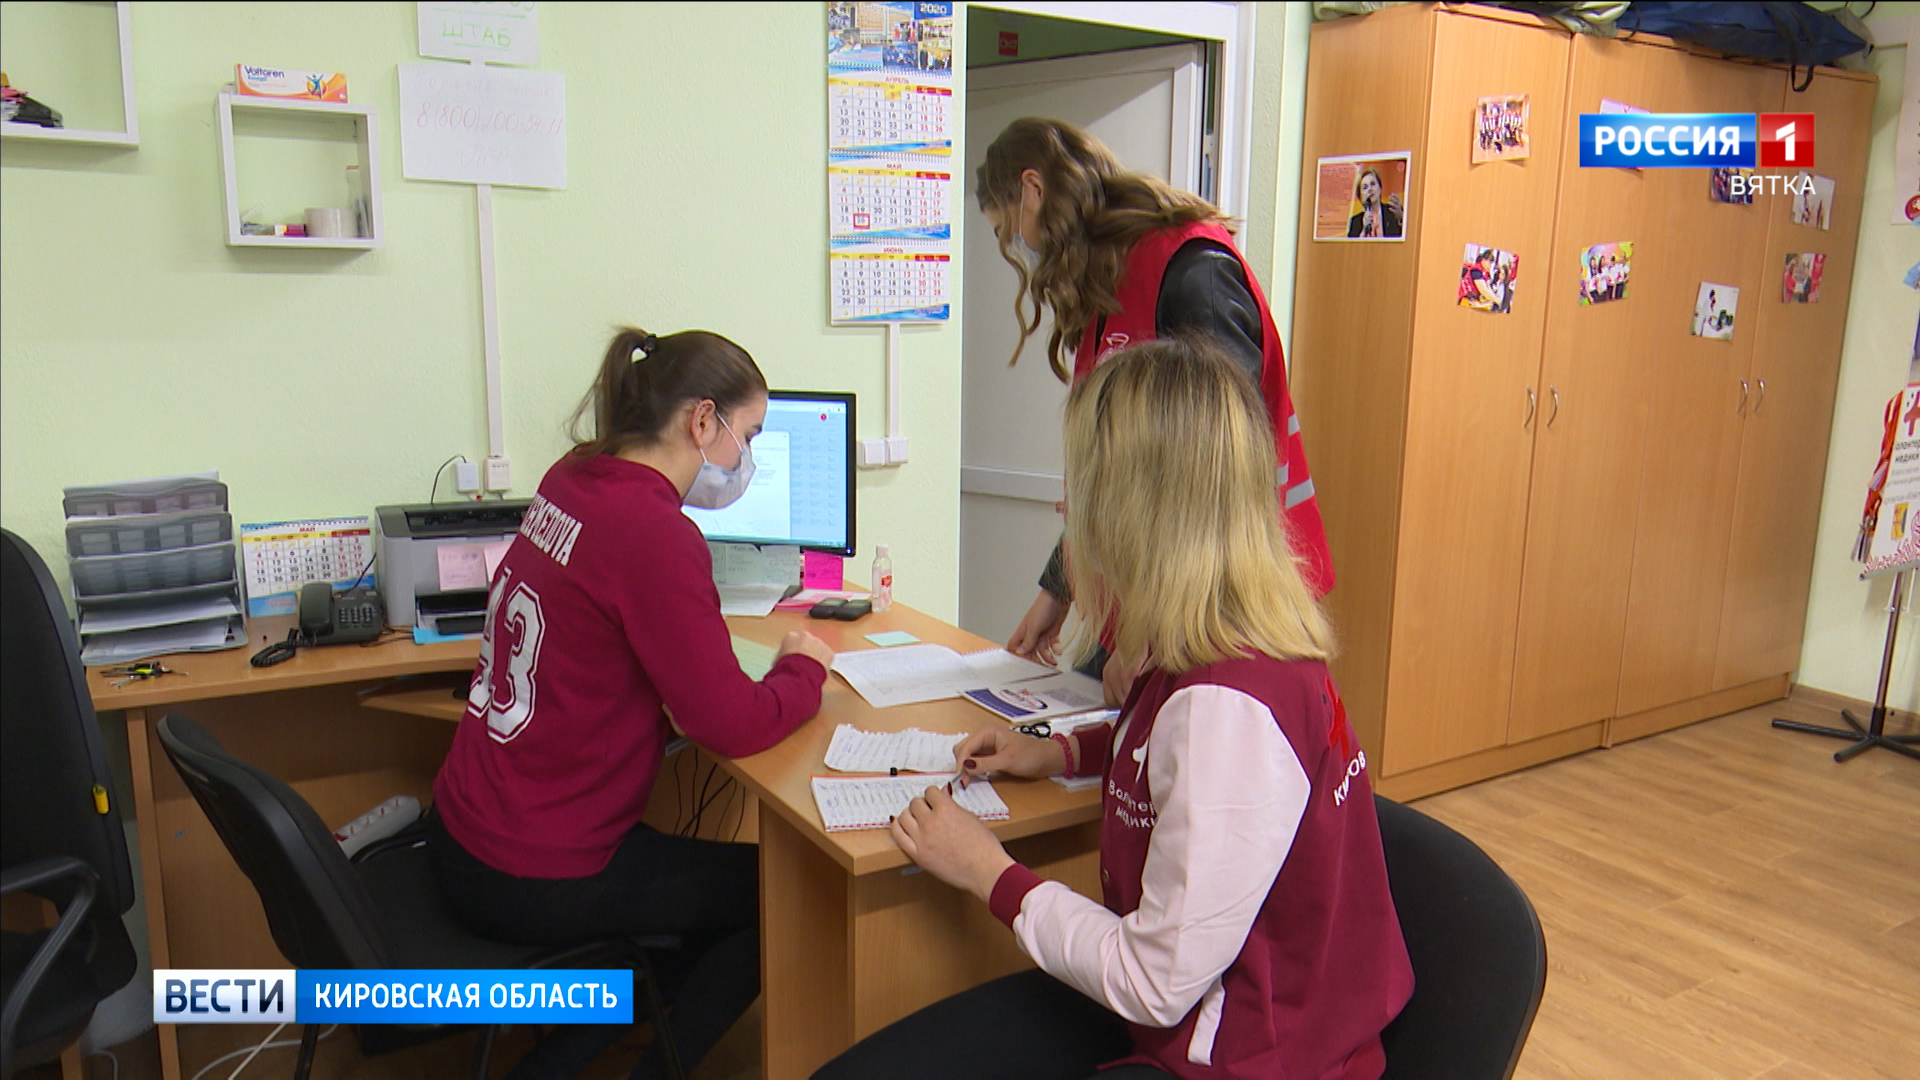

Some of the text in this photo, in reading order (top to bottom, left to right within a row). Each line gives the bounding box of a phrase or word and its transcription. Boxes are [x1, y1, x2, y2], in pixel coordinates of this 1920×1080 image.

[920, 3, 947, 14] 2020
[441, 17, 511, 47] ШТАБ
[244, 66, 285, 78] Voltaren
[885, 76, 910, 84] АПРЕЛЬ
[1333, 749, 1366, 806] КИОВ
